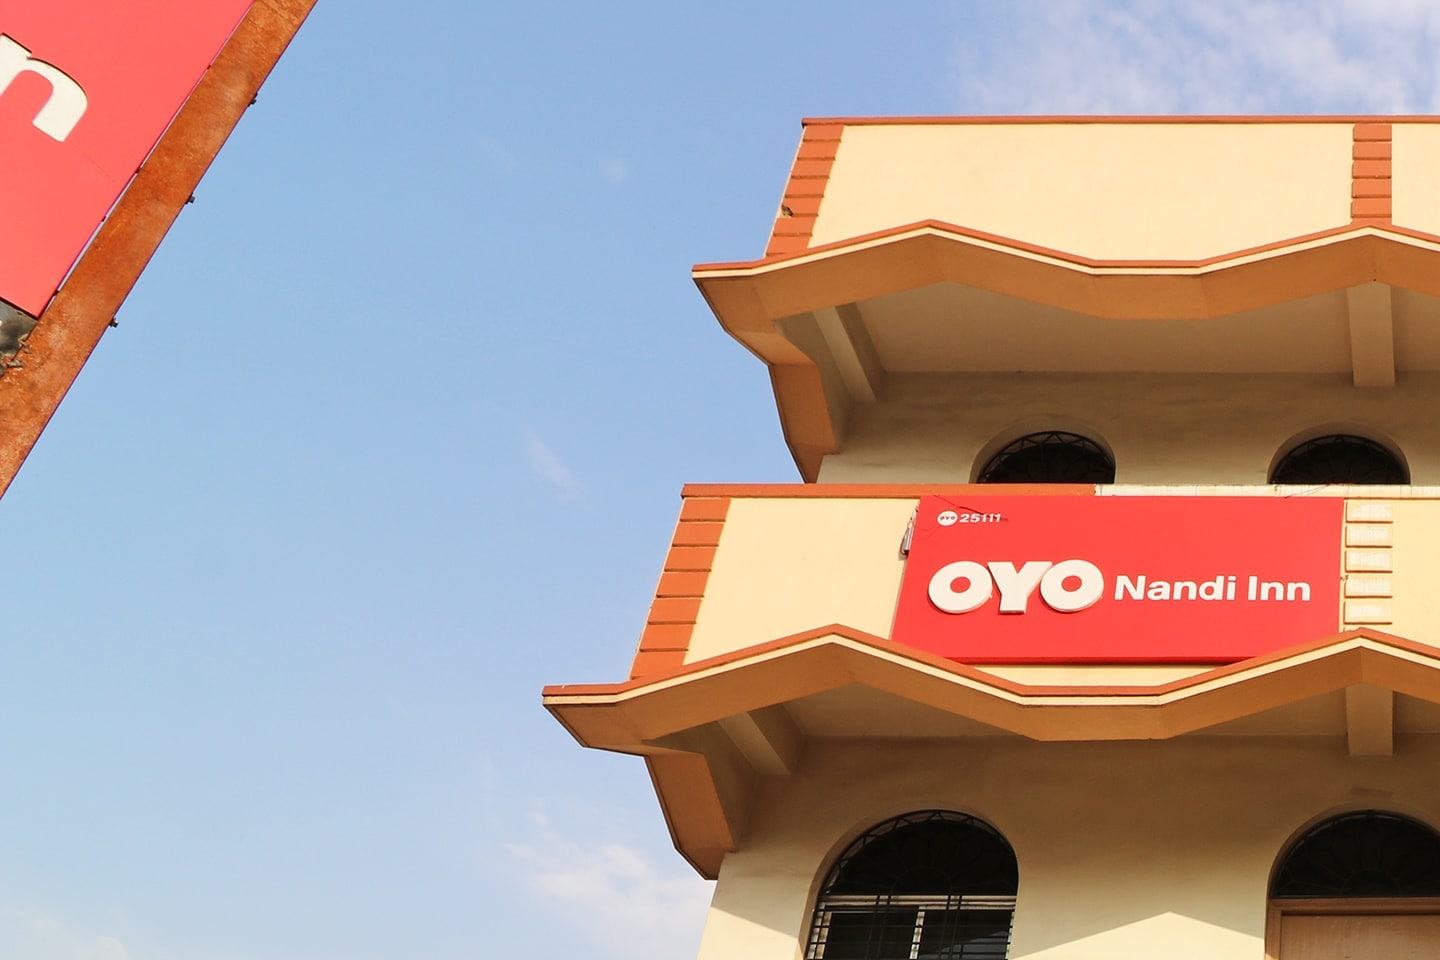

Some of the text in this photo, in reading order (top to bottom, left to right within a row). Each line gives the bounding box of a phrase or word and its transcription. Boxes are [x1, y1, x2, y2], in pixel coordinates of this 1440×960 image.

[928, 559, 1311, 614] OYO Nandi Inn
